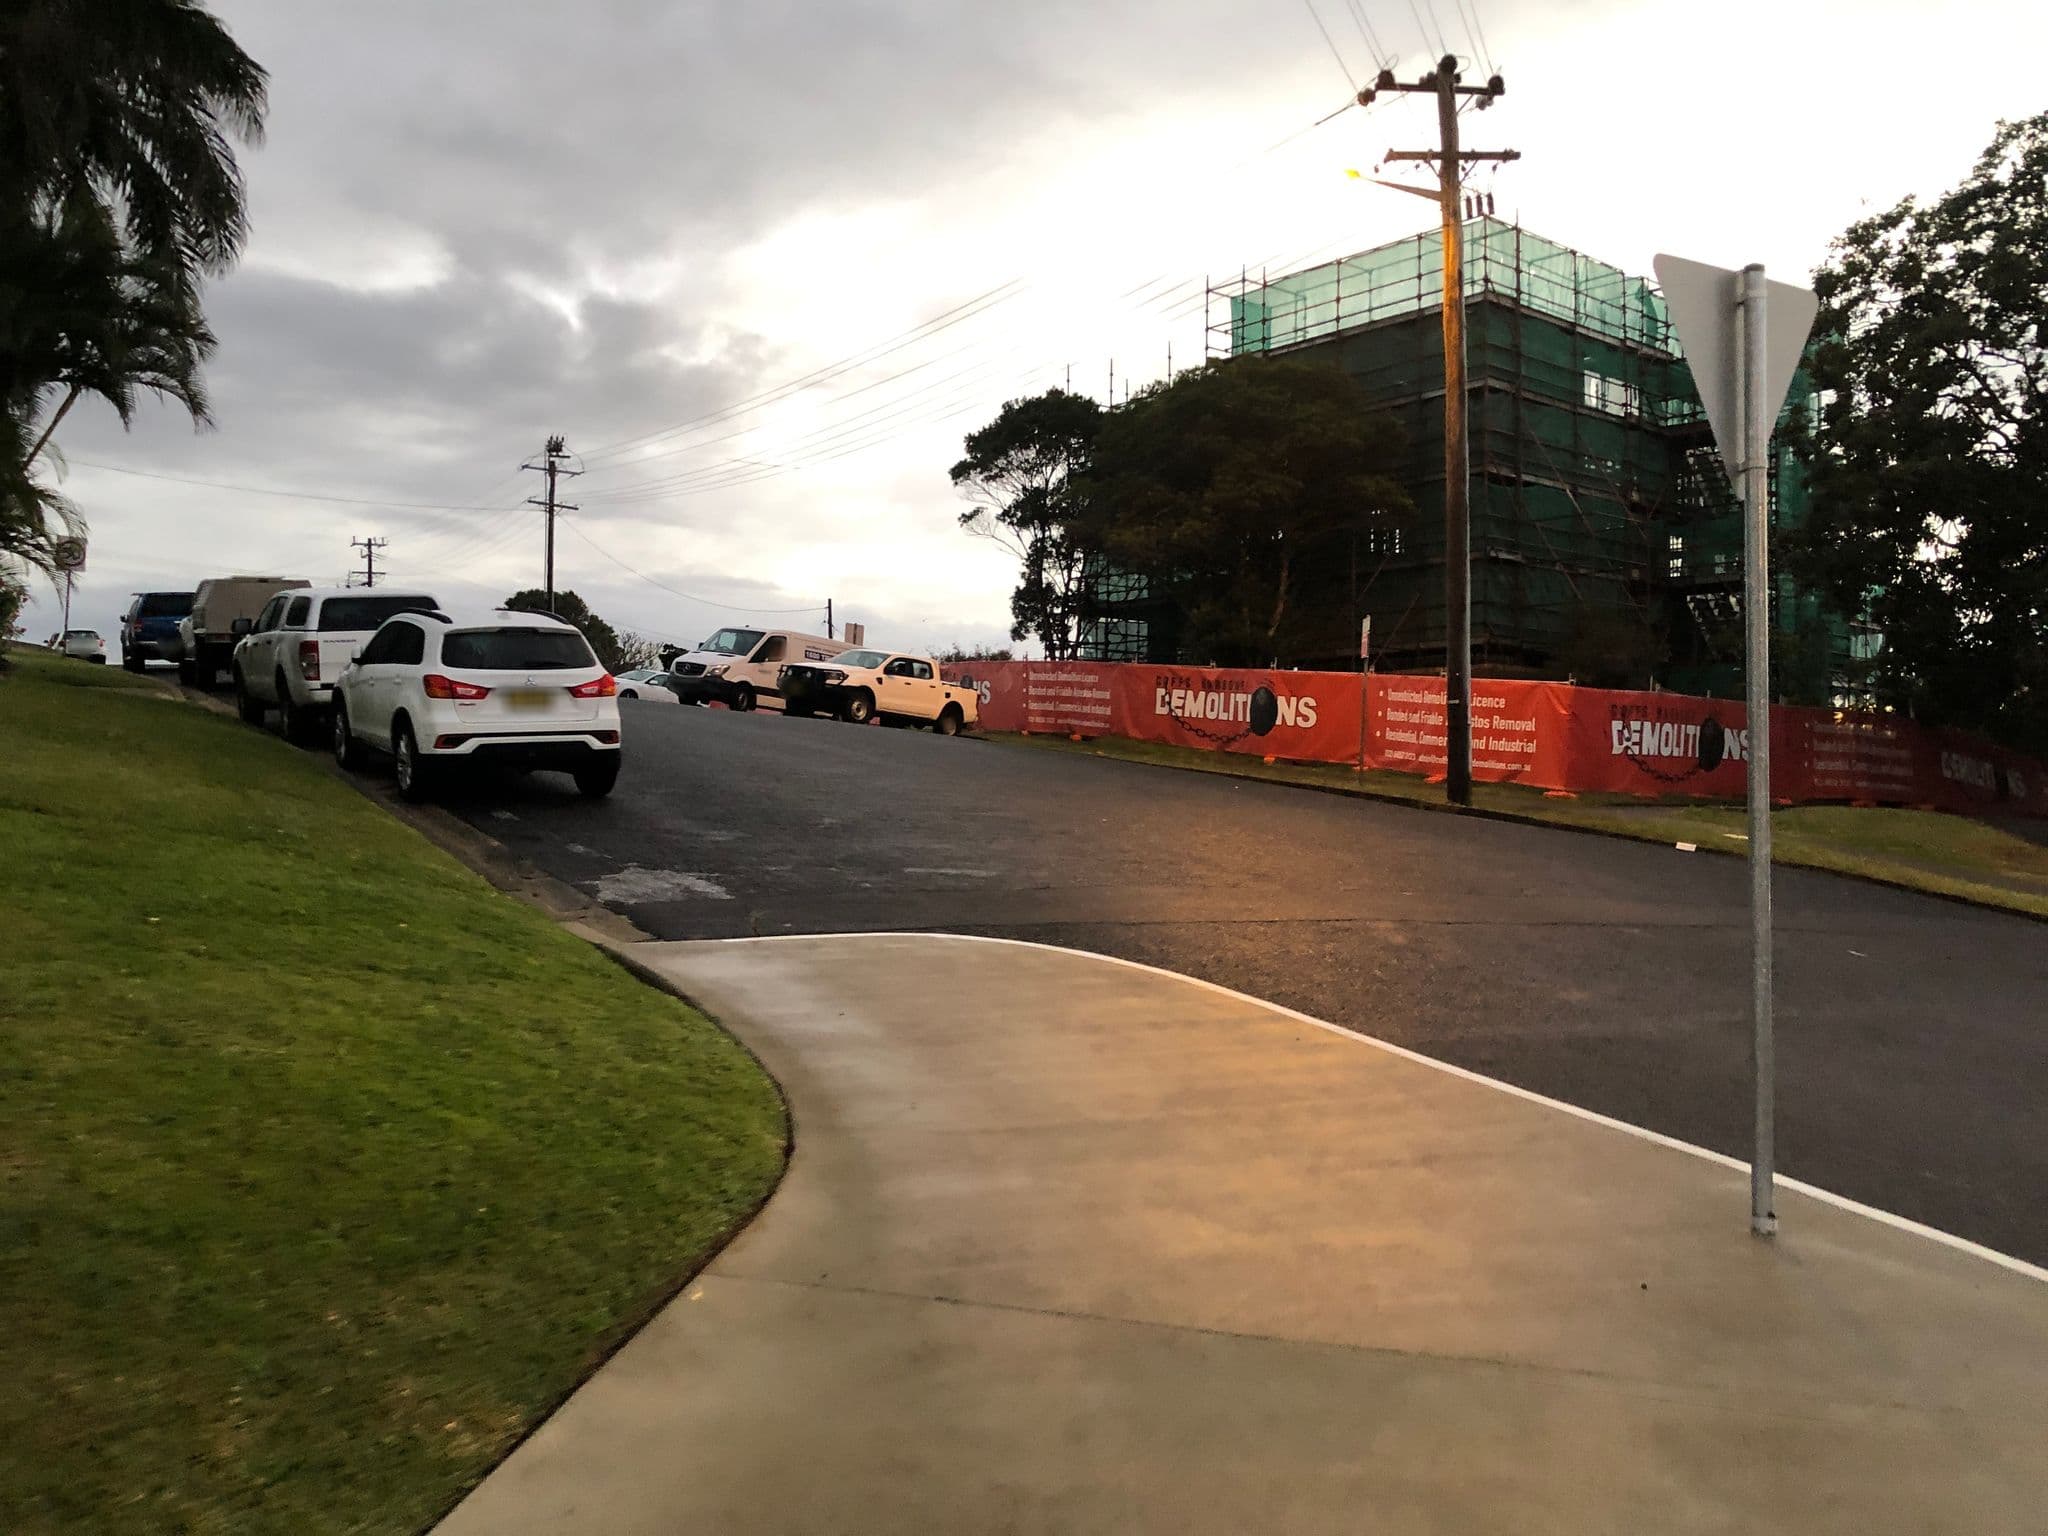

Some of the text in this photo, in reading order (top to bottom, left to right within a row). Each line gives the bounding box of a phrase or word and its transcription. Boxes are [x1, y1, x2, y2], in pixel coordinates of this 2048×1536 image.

[1470, 692, 1506, 709] icence
[1492, 715, 1536, 732] Removal
[1488, 736, 1537, 753] Industrial
